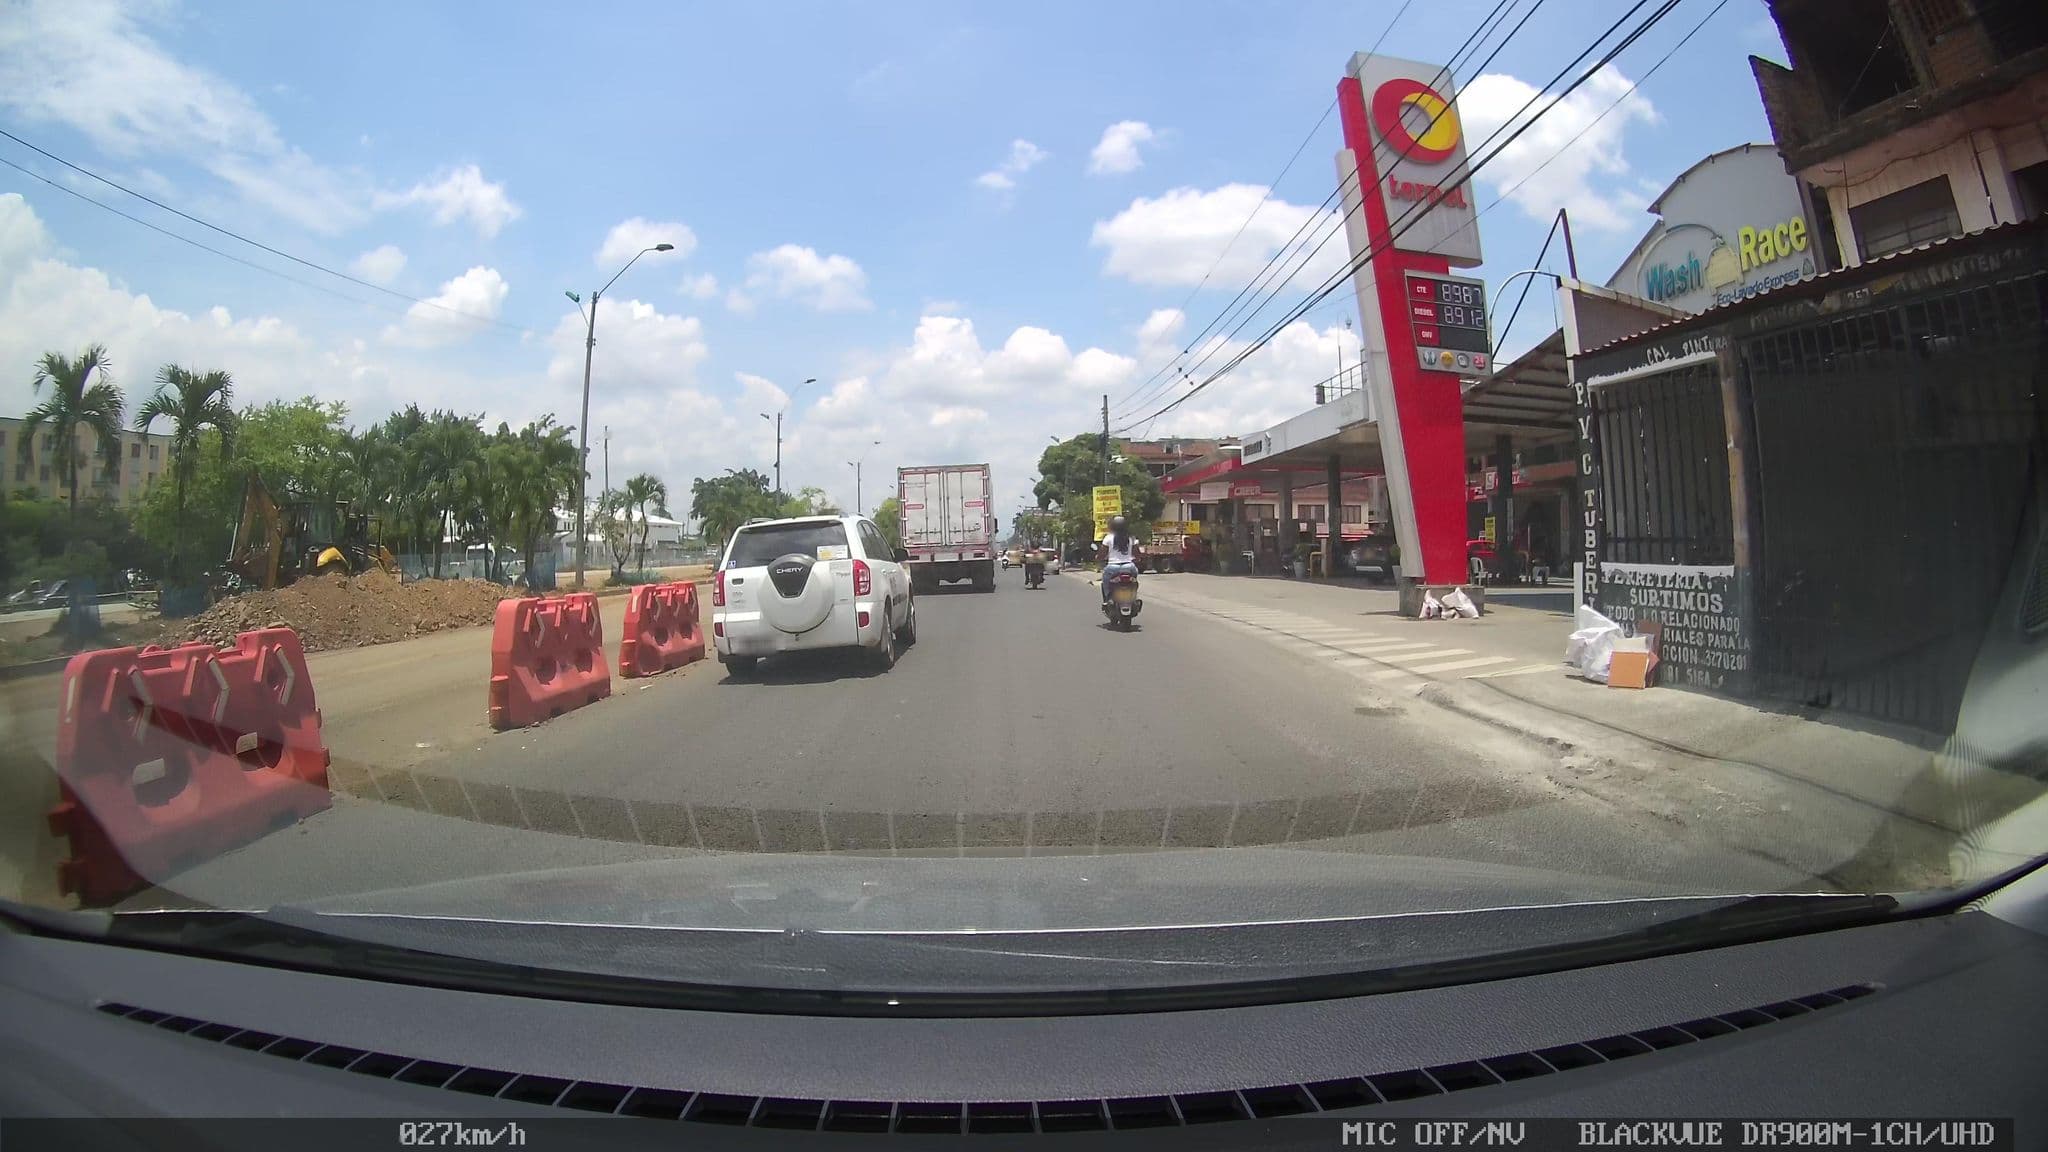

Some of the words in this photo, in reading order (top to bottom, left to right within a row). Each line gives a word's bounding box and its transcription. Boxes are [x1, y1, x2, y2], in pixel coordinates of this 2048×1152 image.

[1647, 251, 1703, 301] Wash
[1739, 215, 1808, 272] Race
[1764, 269, 1799, 289] Express
[1444, 306, 1485, 328] 8912
[1630, 588, 1724, 613] SURTIMOS
[1606, 605, 1636, 622] TODO
[1661, 610, 1740, 634] RELACIONADO
[1664, 628, 1704, 647] RIALES
[1708, 633, 1736, 650] PARA
[1738, 638, 1750, 650] LA
